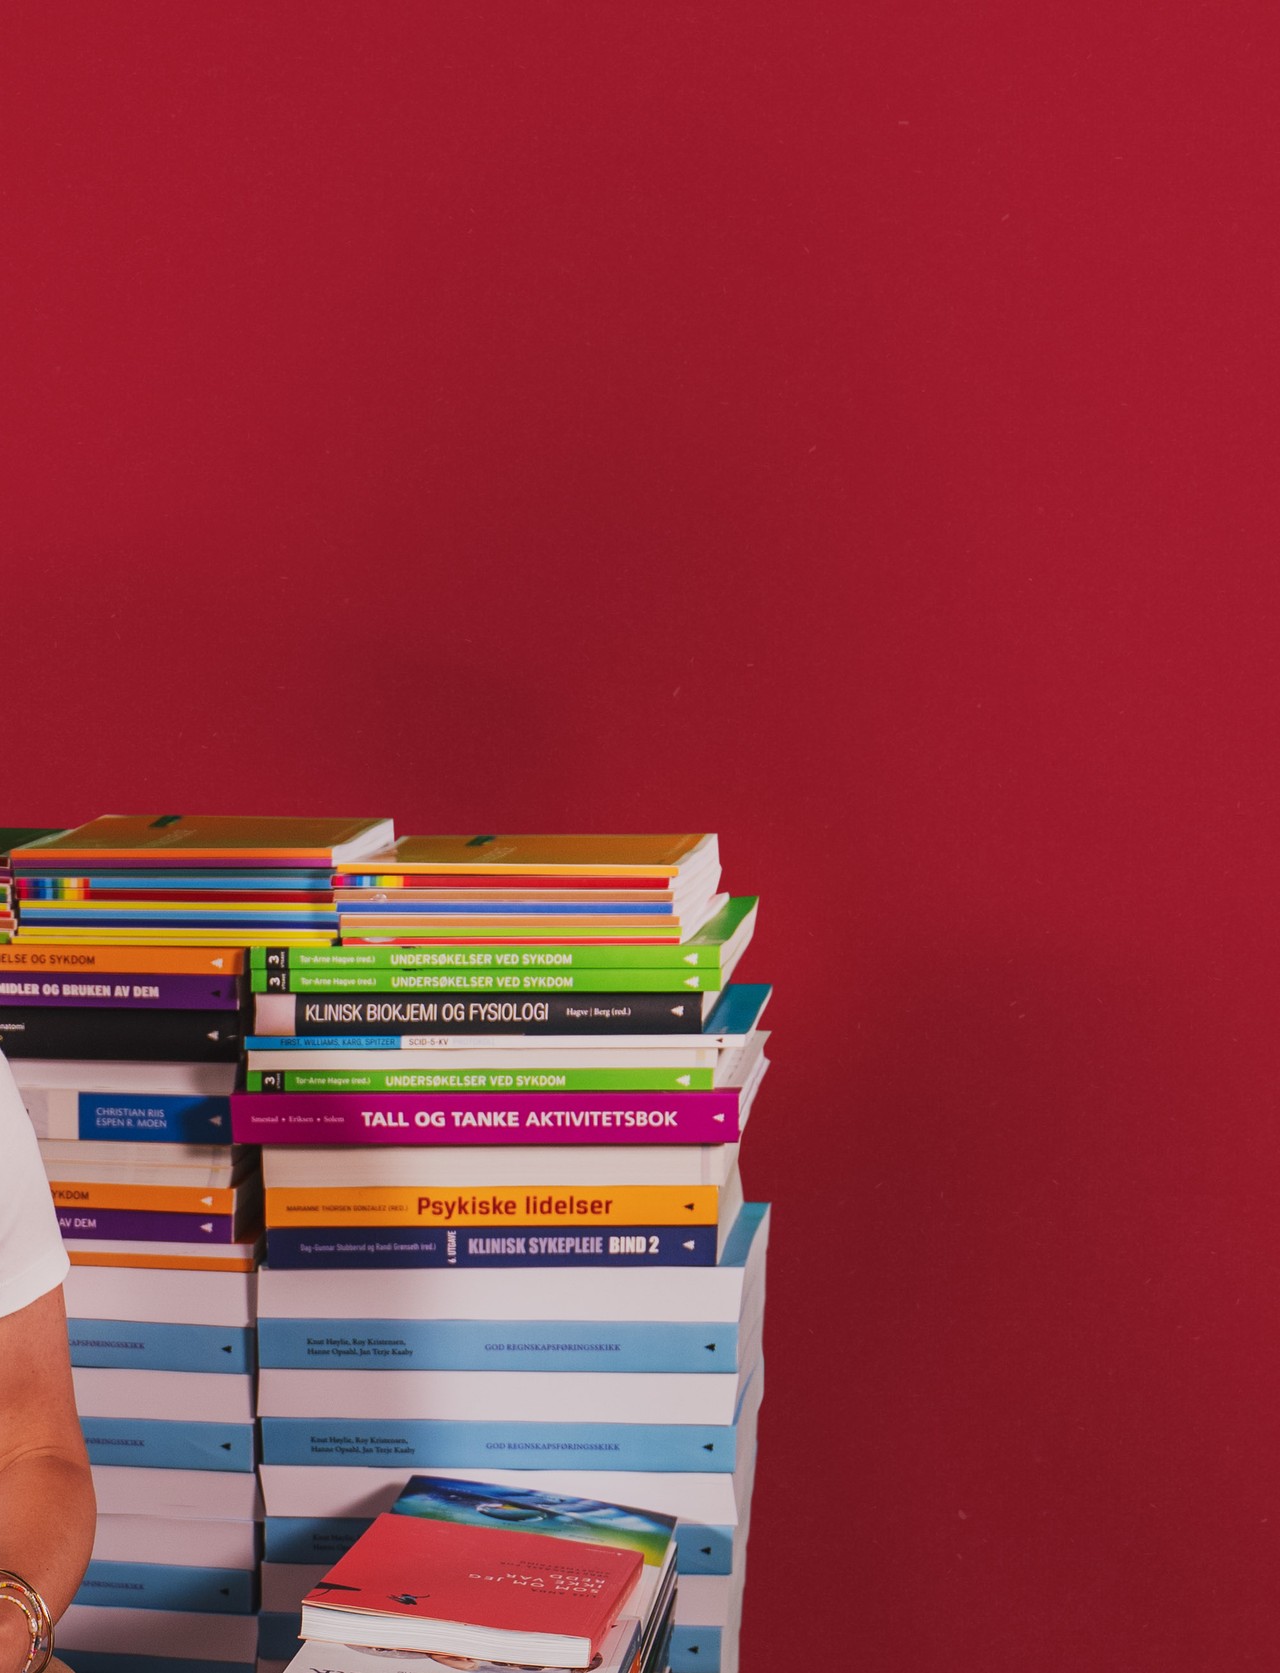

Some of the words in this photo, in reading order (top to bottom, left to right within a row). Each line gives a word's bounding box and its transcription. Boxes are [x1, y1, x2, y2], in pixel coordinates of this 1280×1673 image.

[31, 953, 46, 964] OG
[50, 954, 96, 965] SYKDOM
[268, 955, 280, 964] 3
[299, 955, 330, 963] Tor-Arne
[332, 955, 354, 965] Hagve
[356, 955, 376, 964] (red.)
[390, 954, 491, 965] UNDERSØKELSER
[495, 954, 520, 965] VED
[522, 954, 573, 965] SYKDOM
[269, 977, 281, 987] 3
[301, 977, 331, 985] Tor-Arne
[333, 978, 356, 987] Hagve
[357, 978, 377, 986] (red.)
[391, 976, 492, 988] UNDERSØKELSER
[496, 976, 520, 988] VED
[522, 976, 574, 988] SYKDOM
[42, 983, 59, 996] OG
[62, 984, 111, 997] BRUKEN
[114, 985, 131, 998] AV
[133, 985, 160, 998] DEM
[305, 1003, 363, 1022] KLINISK
[366, 1003, 438, 1022] BIOKJEMI
[441, 1003, 465, 1022] OG
[469, 1003, 549, 1022] FYSIOLOGI
[566, 1006, 590, 1017] Hagve
[593, 1006, 610, 1017] Berg
[612, 1006, 632, 1017] (red.)
[280, 1038, 303, 1047] FIRST,
[304, 1038, 341, 1047] WILLIAMS,
[342, 1038, 363, 1047] KARG,
[365, 1038, 396, 1046] SPITZER
[265, 1076, 276, 1085] 3
[295, 1076, 326, 1084] Tor-Arne
[327, 1077, 350, 1086] Hagve
[351, 1076, 371, 1085] (red.)
[385, 1075, 486, 1087] UNDERSØKELSER
[489, 1075, 513, 1087] VED
[515, 1075, 566, 1087] SYKDOM
[96, 1107, 146, 1117] CHRISTIAN
[147, 1109, 165, 1118] RIIS
[96, 1117, 125, 1127] ESPEN
[127, 1118, 134, 1127] R.
[137, 1119, 167, 1128] MOEN
[361, 1111, 410, 1128] TALL
[414, 1111, 446, 1128] OG
[451, 1111, 520, 1128] TANKE
[525, 1110, 678, 1128] AKTIVITETSBOK
[417, 1195, 517, 1220] Psykiske
[525, 1195, 613, 1216] lidelser
[59, 1217, 72, 1228] AV
[74, 1218, 97, 1228] DEM
[447, 1230, 457, 1255] UTGAVE
[468, 1237, 526, 1255] KLINISK
[529, 1236, 603, 1254] SYKEPLEIE
[609, 1236, 646, 1254] BIND
[649, 1236, 659, 1253] 2
[484, 1343, 505, 1351] GOD
[486, 1442, 505, 1450] GOD
[468, 1573, 505, 1582] JEG
[506, 1573, 544, 1582] VAR
[549, 1573, 606, 1584] REDD
[513, 1580, 545, 1588] OM
[555, 1579, 602, 1589] IKKE
[555, 1585, 599, 1594] SOM
